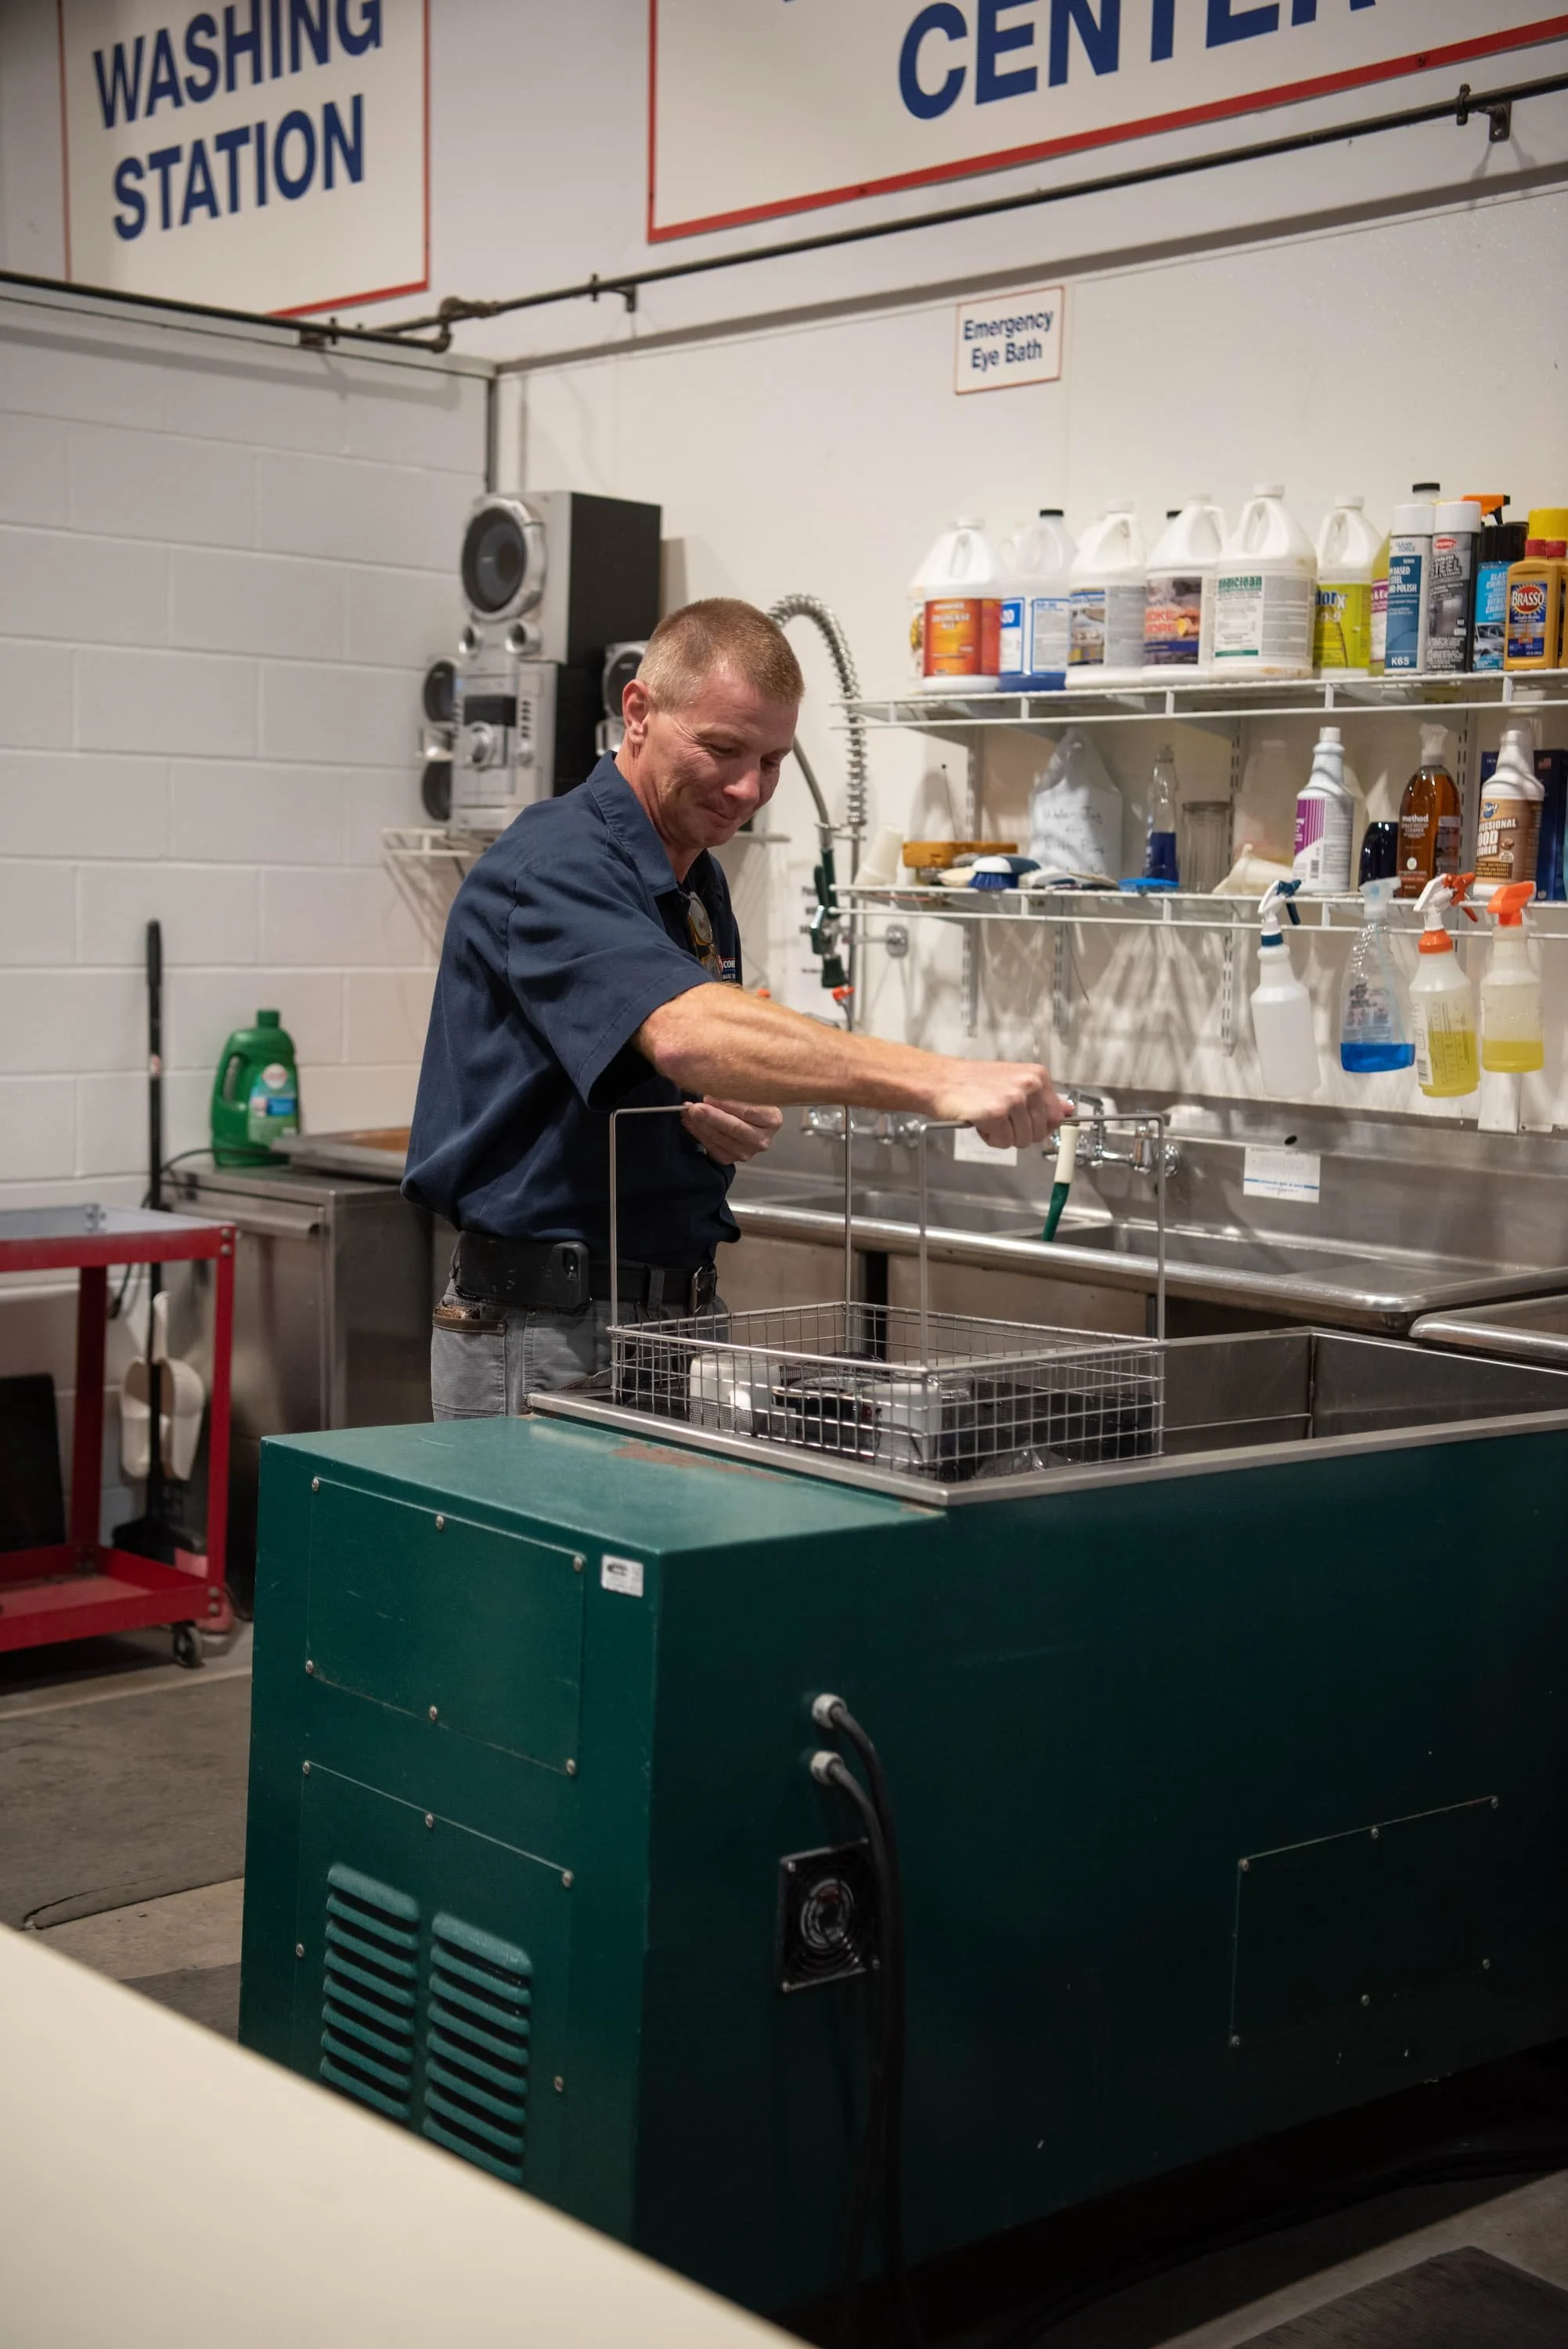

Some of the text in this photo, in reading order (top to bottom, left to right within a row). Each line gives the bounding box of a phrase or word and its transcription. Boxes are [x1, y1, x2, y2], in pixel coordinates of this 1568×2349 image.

[92, 0, 383, 129] WASHING
[898, 0, 1376, 120] CENT
[113, 93, 365, 241] STATION
[964, 311, 1054, 341] Emergency
[971, 337, 1043, 372] Eye Bath
[1397, 583, 1417, 594] POLISH
[1511, 590, 1545, 607] BRASSO
[1401, 814, 1429, 823] method
